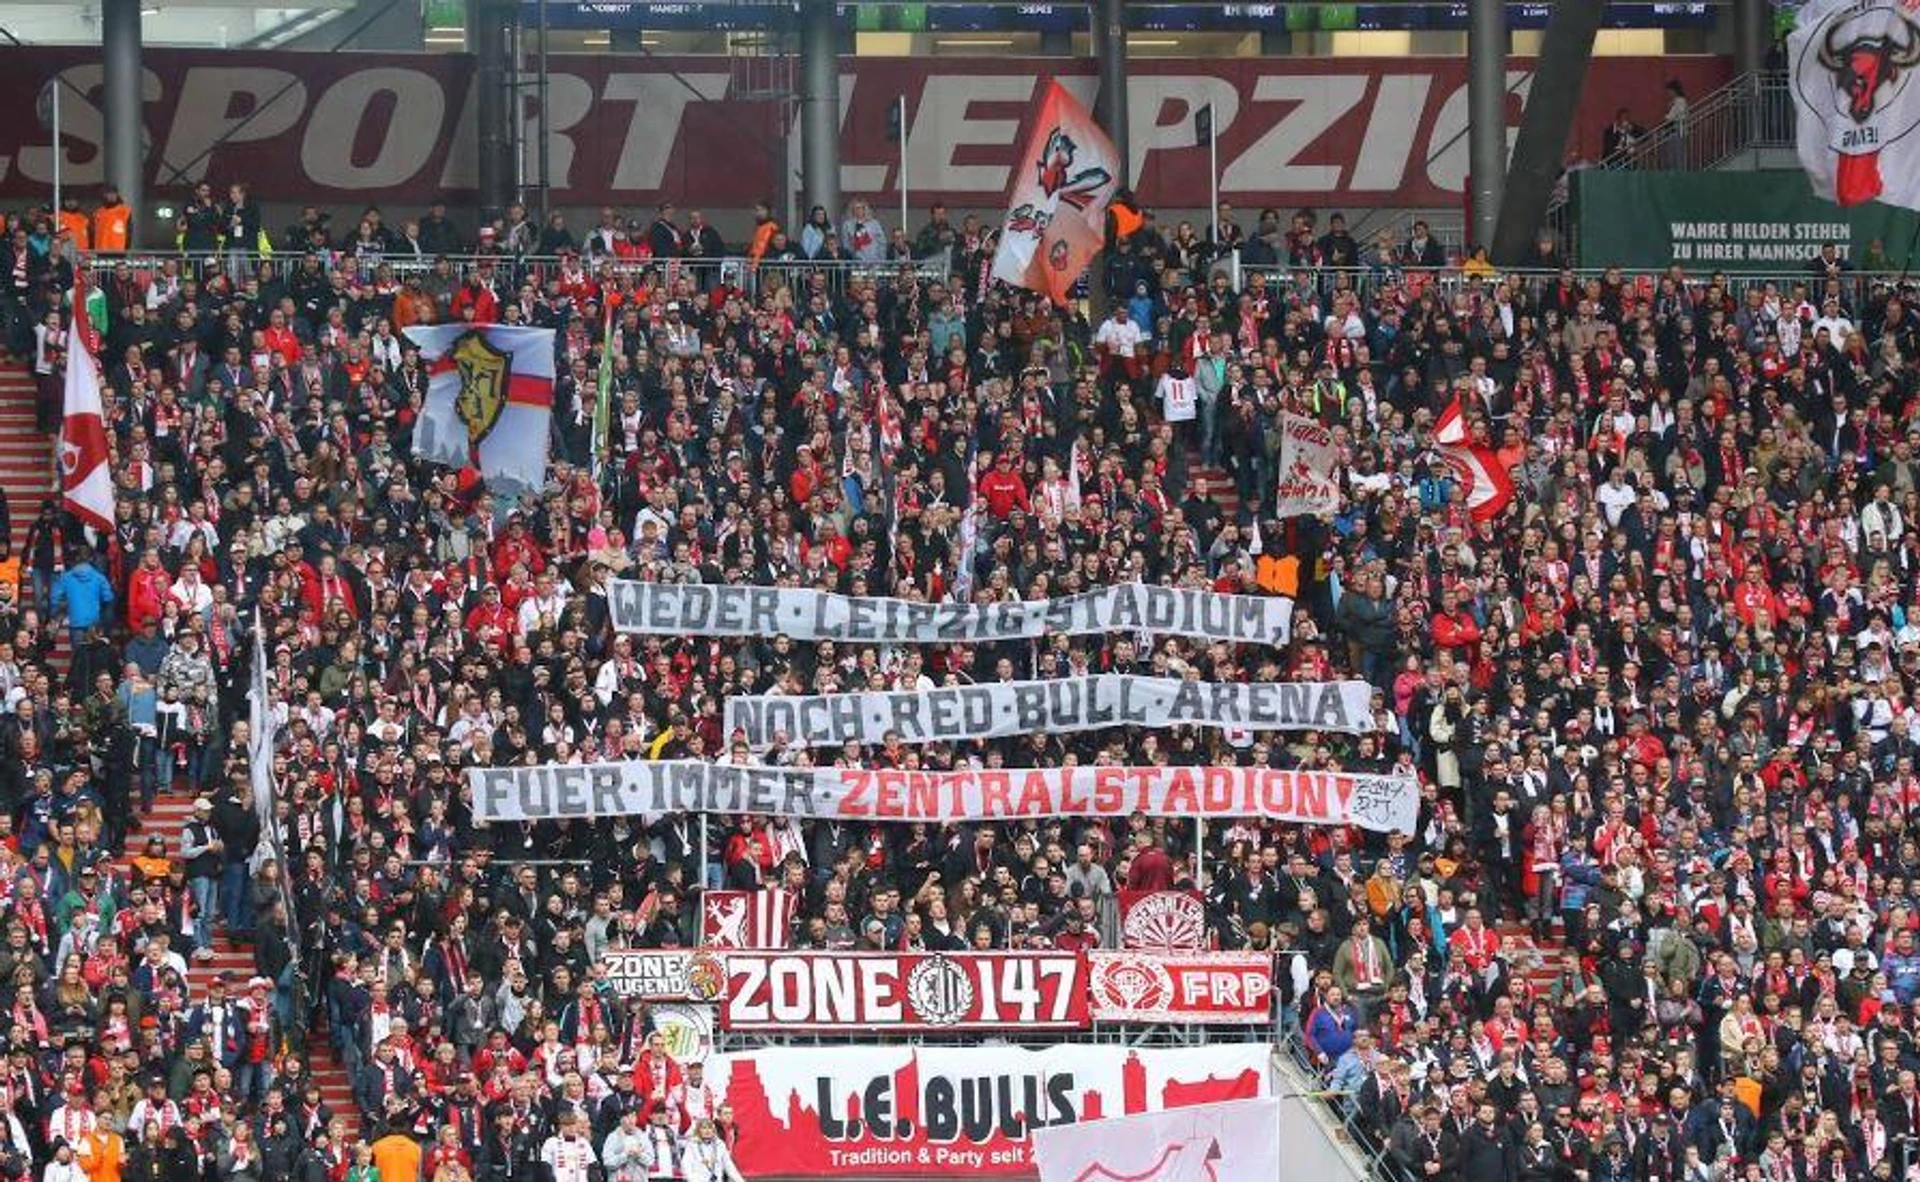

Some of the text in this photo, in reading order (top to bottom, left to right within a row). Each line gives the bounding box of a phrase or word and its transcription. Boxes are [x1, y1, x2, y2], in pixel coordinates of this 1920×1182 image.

[0, 64, 731, 190] SPORT
[1671, 223, 1851, 239] WAHRE HELDEN STEHEN
[1672, 243, 1850, 260] ZU IHRER MANNSCHFT
[613, 582, 1284, 641] WEDER LEIPZIG STADIUM,
[733, 694, 864, 745] NOCH
[888, 687, 993, 738] RED
[1014, 676, 1147, 730] BULL
[484, 762, 1355, 820] FUER IMMER ZENTRALSTADION!
[604, 955, 682, 977] ZONE
[728, 957, 904, 1023] ZONE
[975, 958, 1078, 1022] 147
[1181, 970, 1271, 1008] FRP
[816, 1073, 1076, 1144] L.E. BULLS
[830, 1149, 911, 1166] Tradition
[917, 1152, 930, 1164] &
[936, 1148, 984, 1168] Party
[991, 1147, 1025, 1165] seit
